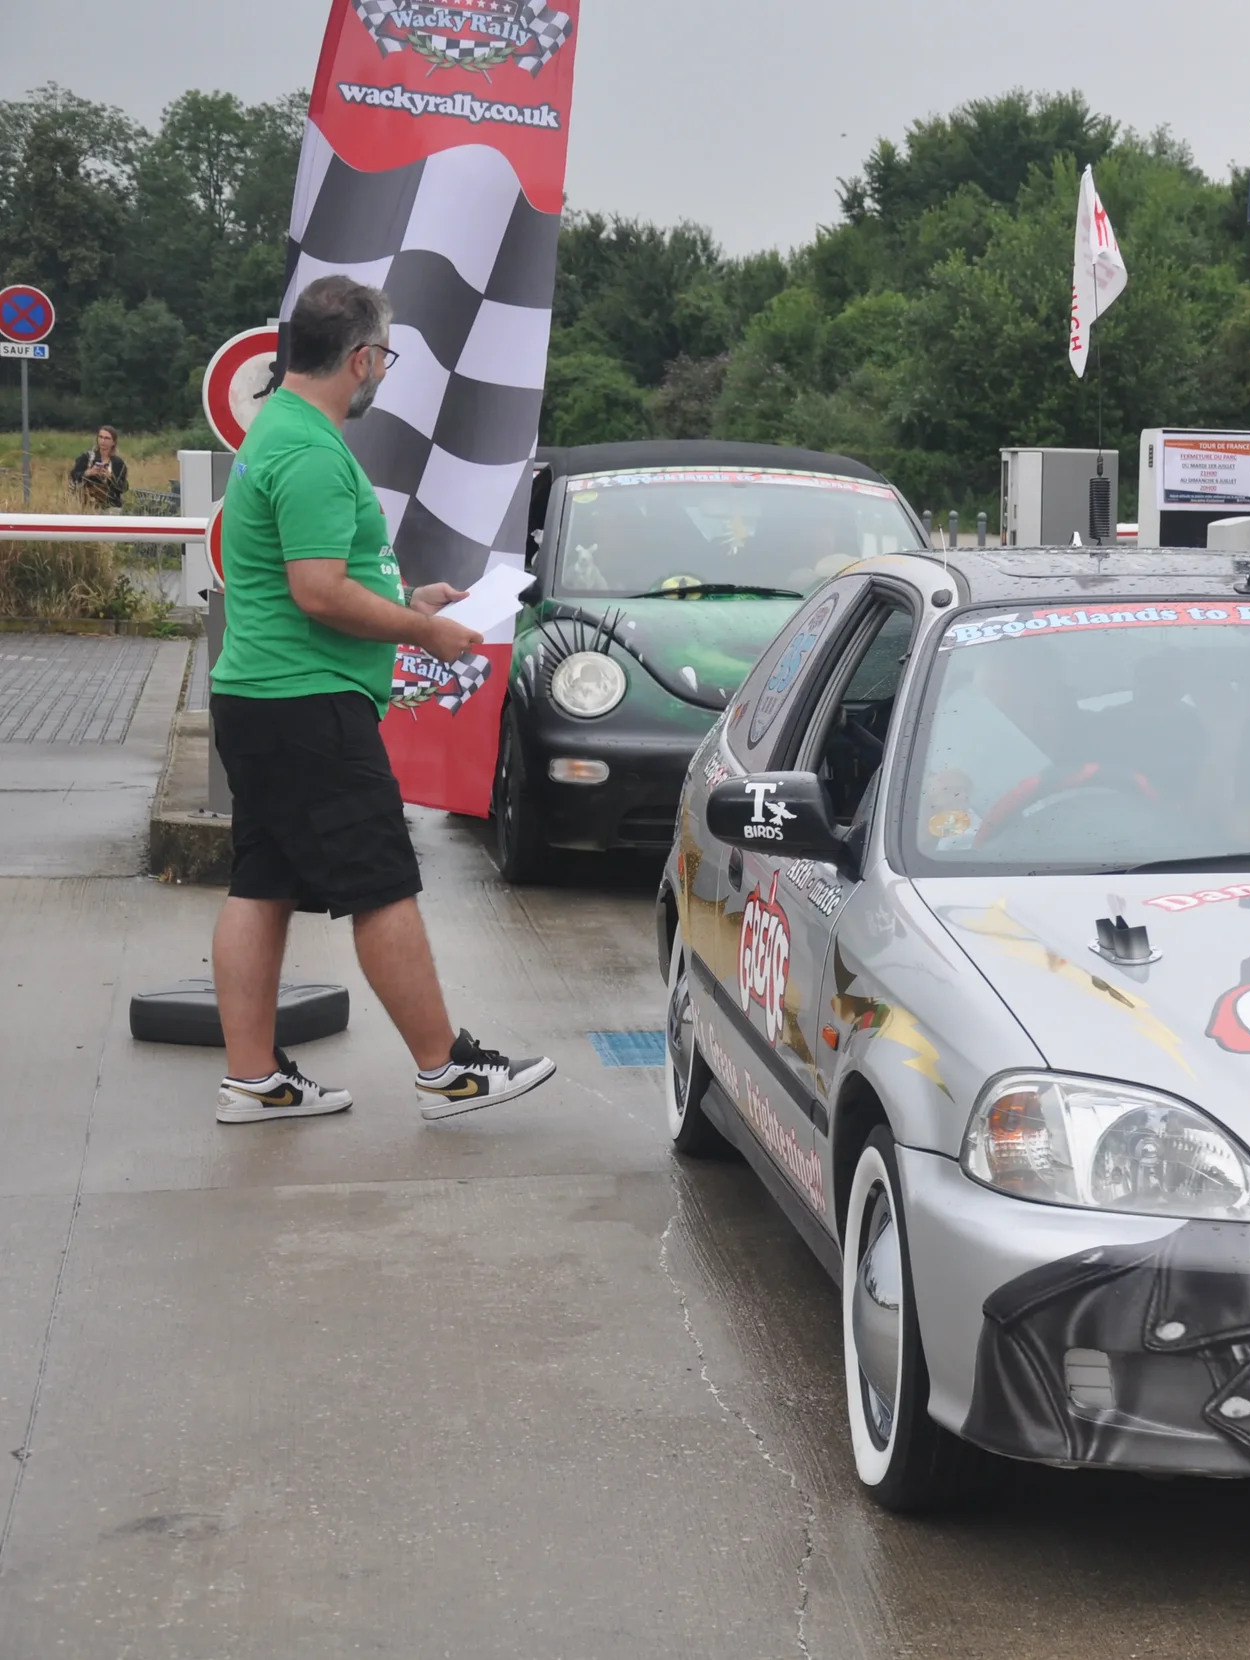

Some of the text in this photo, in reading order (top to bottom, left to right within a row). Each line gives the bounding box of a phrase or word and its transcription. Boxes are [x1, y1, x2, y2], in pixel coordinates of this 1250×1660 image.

[389, 9, 533, 47] Wacky Rally
[338, 81, 562, 129] wackyrally.co.uk
[3, 345, 31, 355] SAUF
[954, 607, 1180, 643] Brooklands
[1186, 606, 1228, 621] to
[401, 655, 455, 687] Rally
[744, 825, 784, 841] BIRDS
[738, 898, 790, 1045] GREASE
